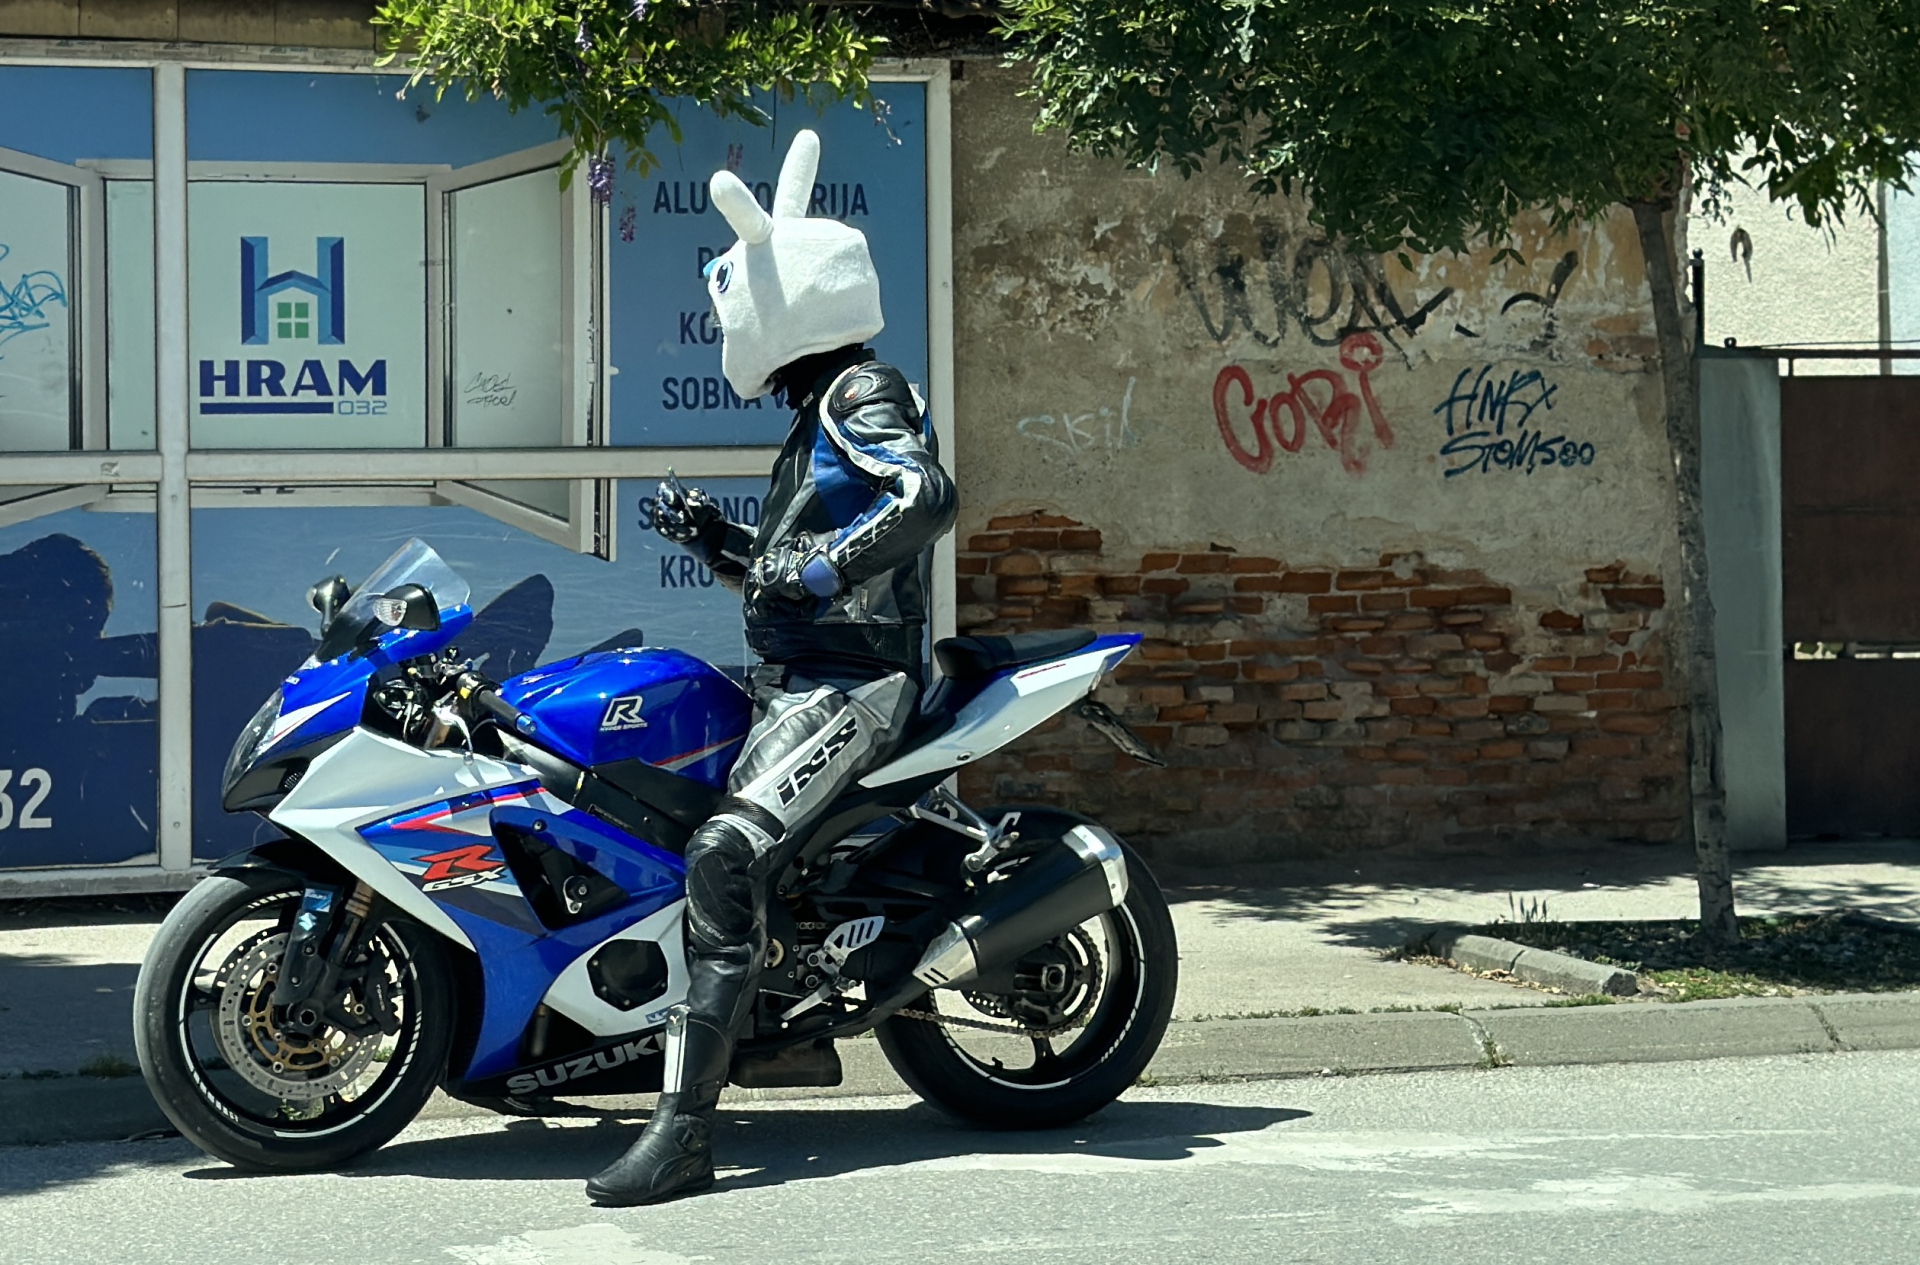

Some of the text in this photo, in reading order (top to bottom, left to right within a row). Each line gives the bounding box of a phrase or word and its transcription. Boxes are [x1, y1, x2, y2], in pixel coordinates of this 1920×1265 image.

[199, 359, 387, 397] HRAM
[338, 400, 387, 415] 032
[602, 696, 645, 727] R
[422, 866, 506, 892] GSX
[506, 1032, 666, 1094] SUZUKI
